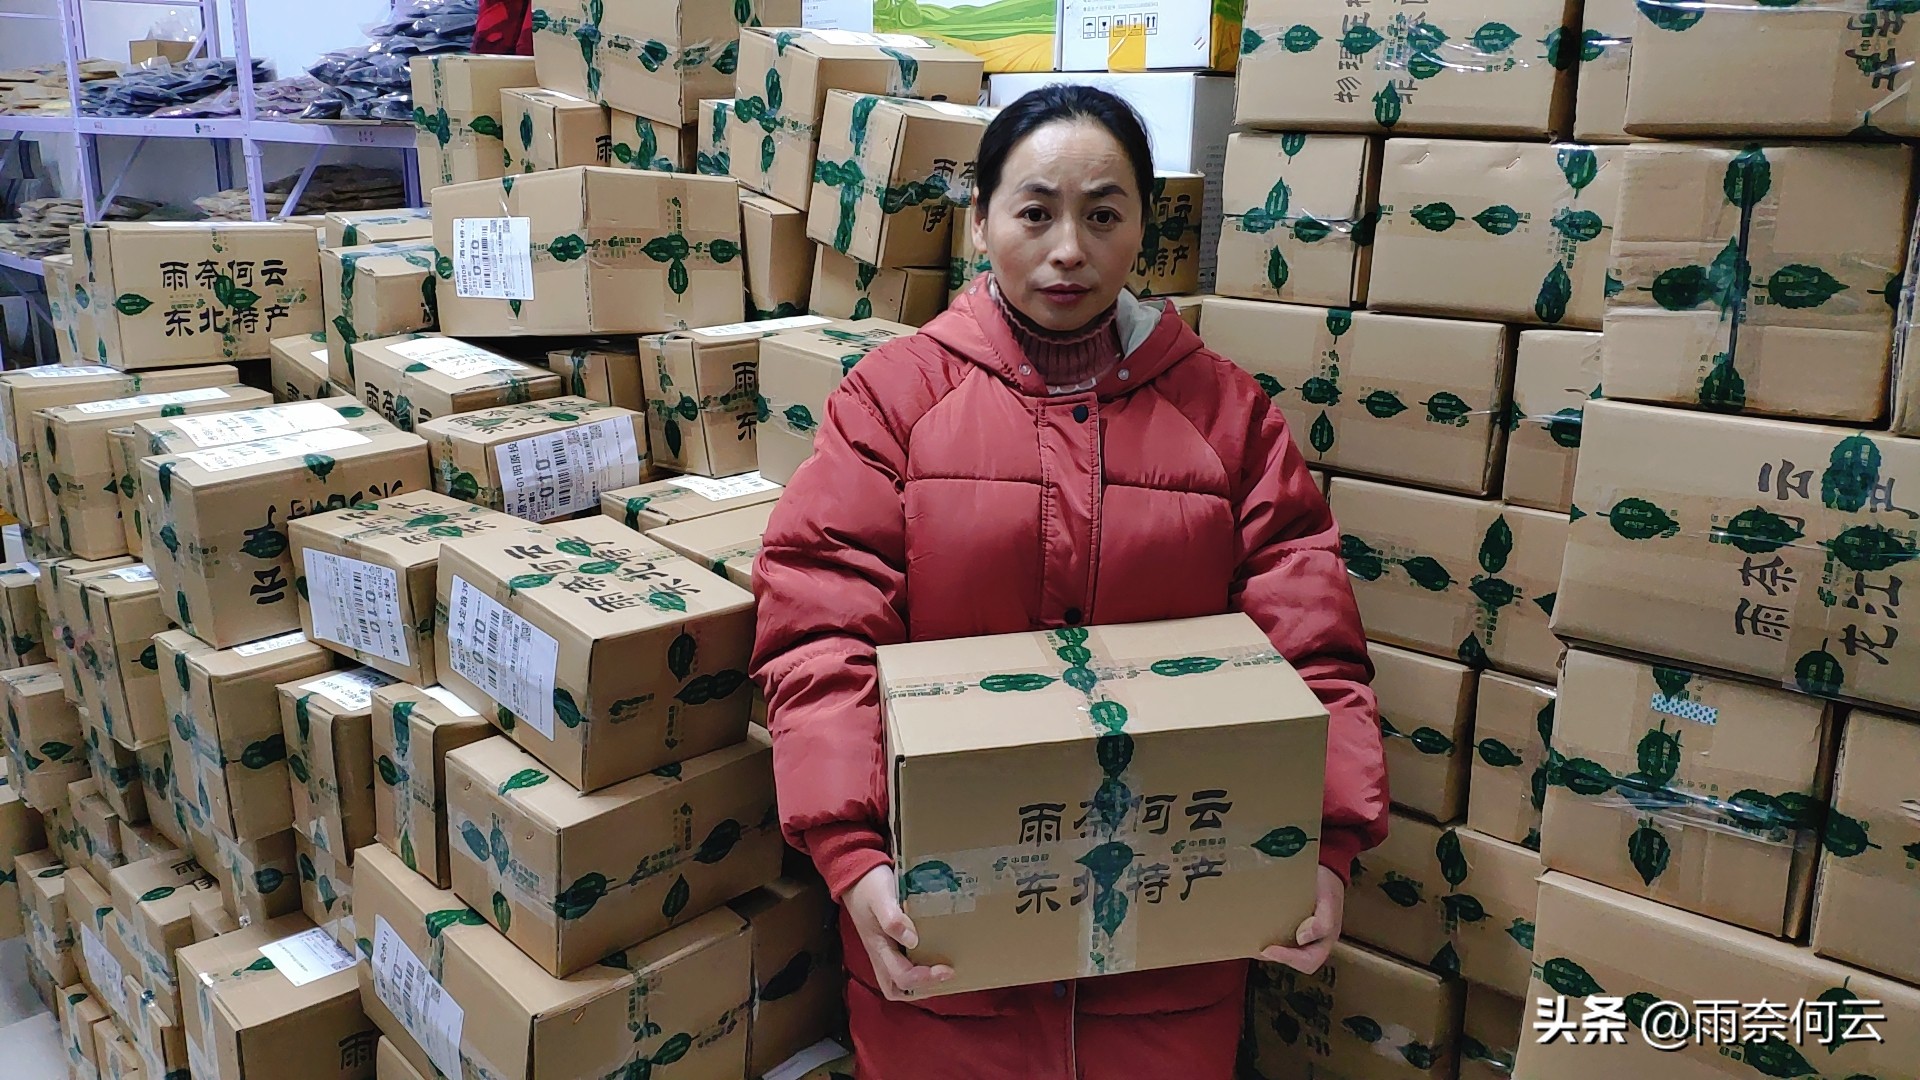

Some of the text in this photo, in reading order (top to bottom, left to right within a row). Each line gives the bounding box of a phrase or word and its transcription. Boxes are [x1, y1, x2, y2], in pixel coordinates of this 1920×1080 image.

[160, 260, 289, 291] 雨奈何云
[163, 304, 291, 338] 东北特产
[536, 459, 554, 498] 010
[1735, 459, 1814, 642] 雨奈云
[1838, 478, 1920, 666] 龙江产
[365, 590, 381, 633] 010
[473, 619, 486, 665] 010
[1019, 789, 1233, 848] 雨奈何云
